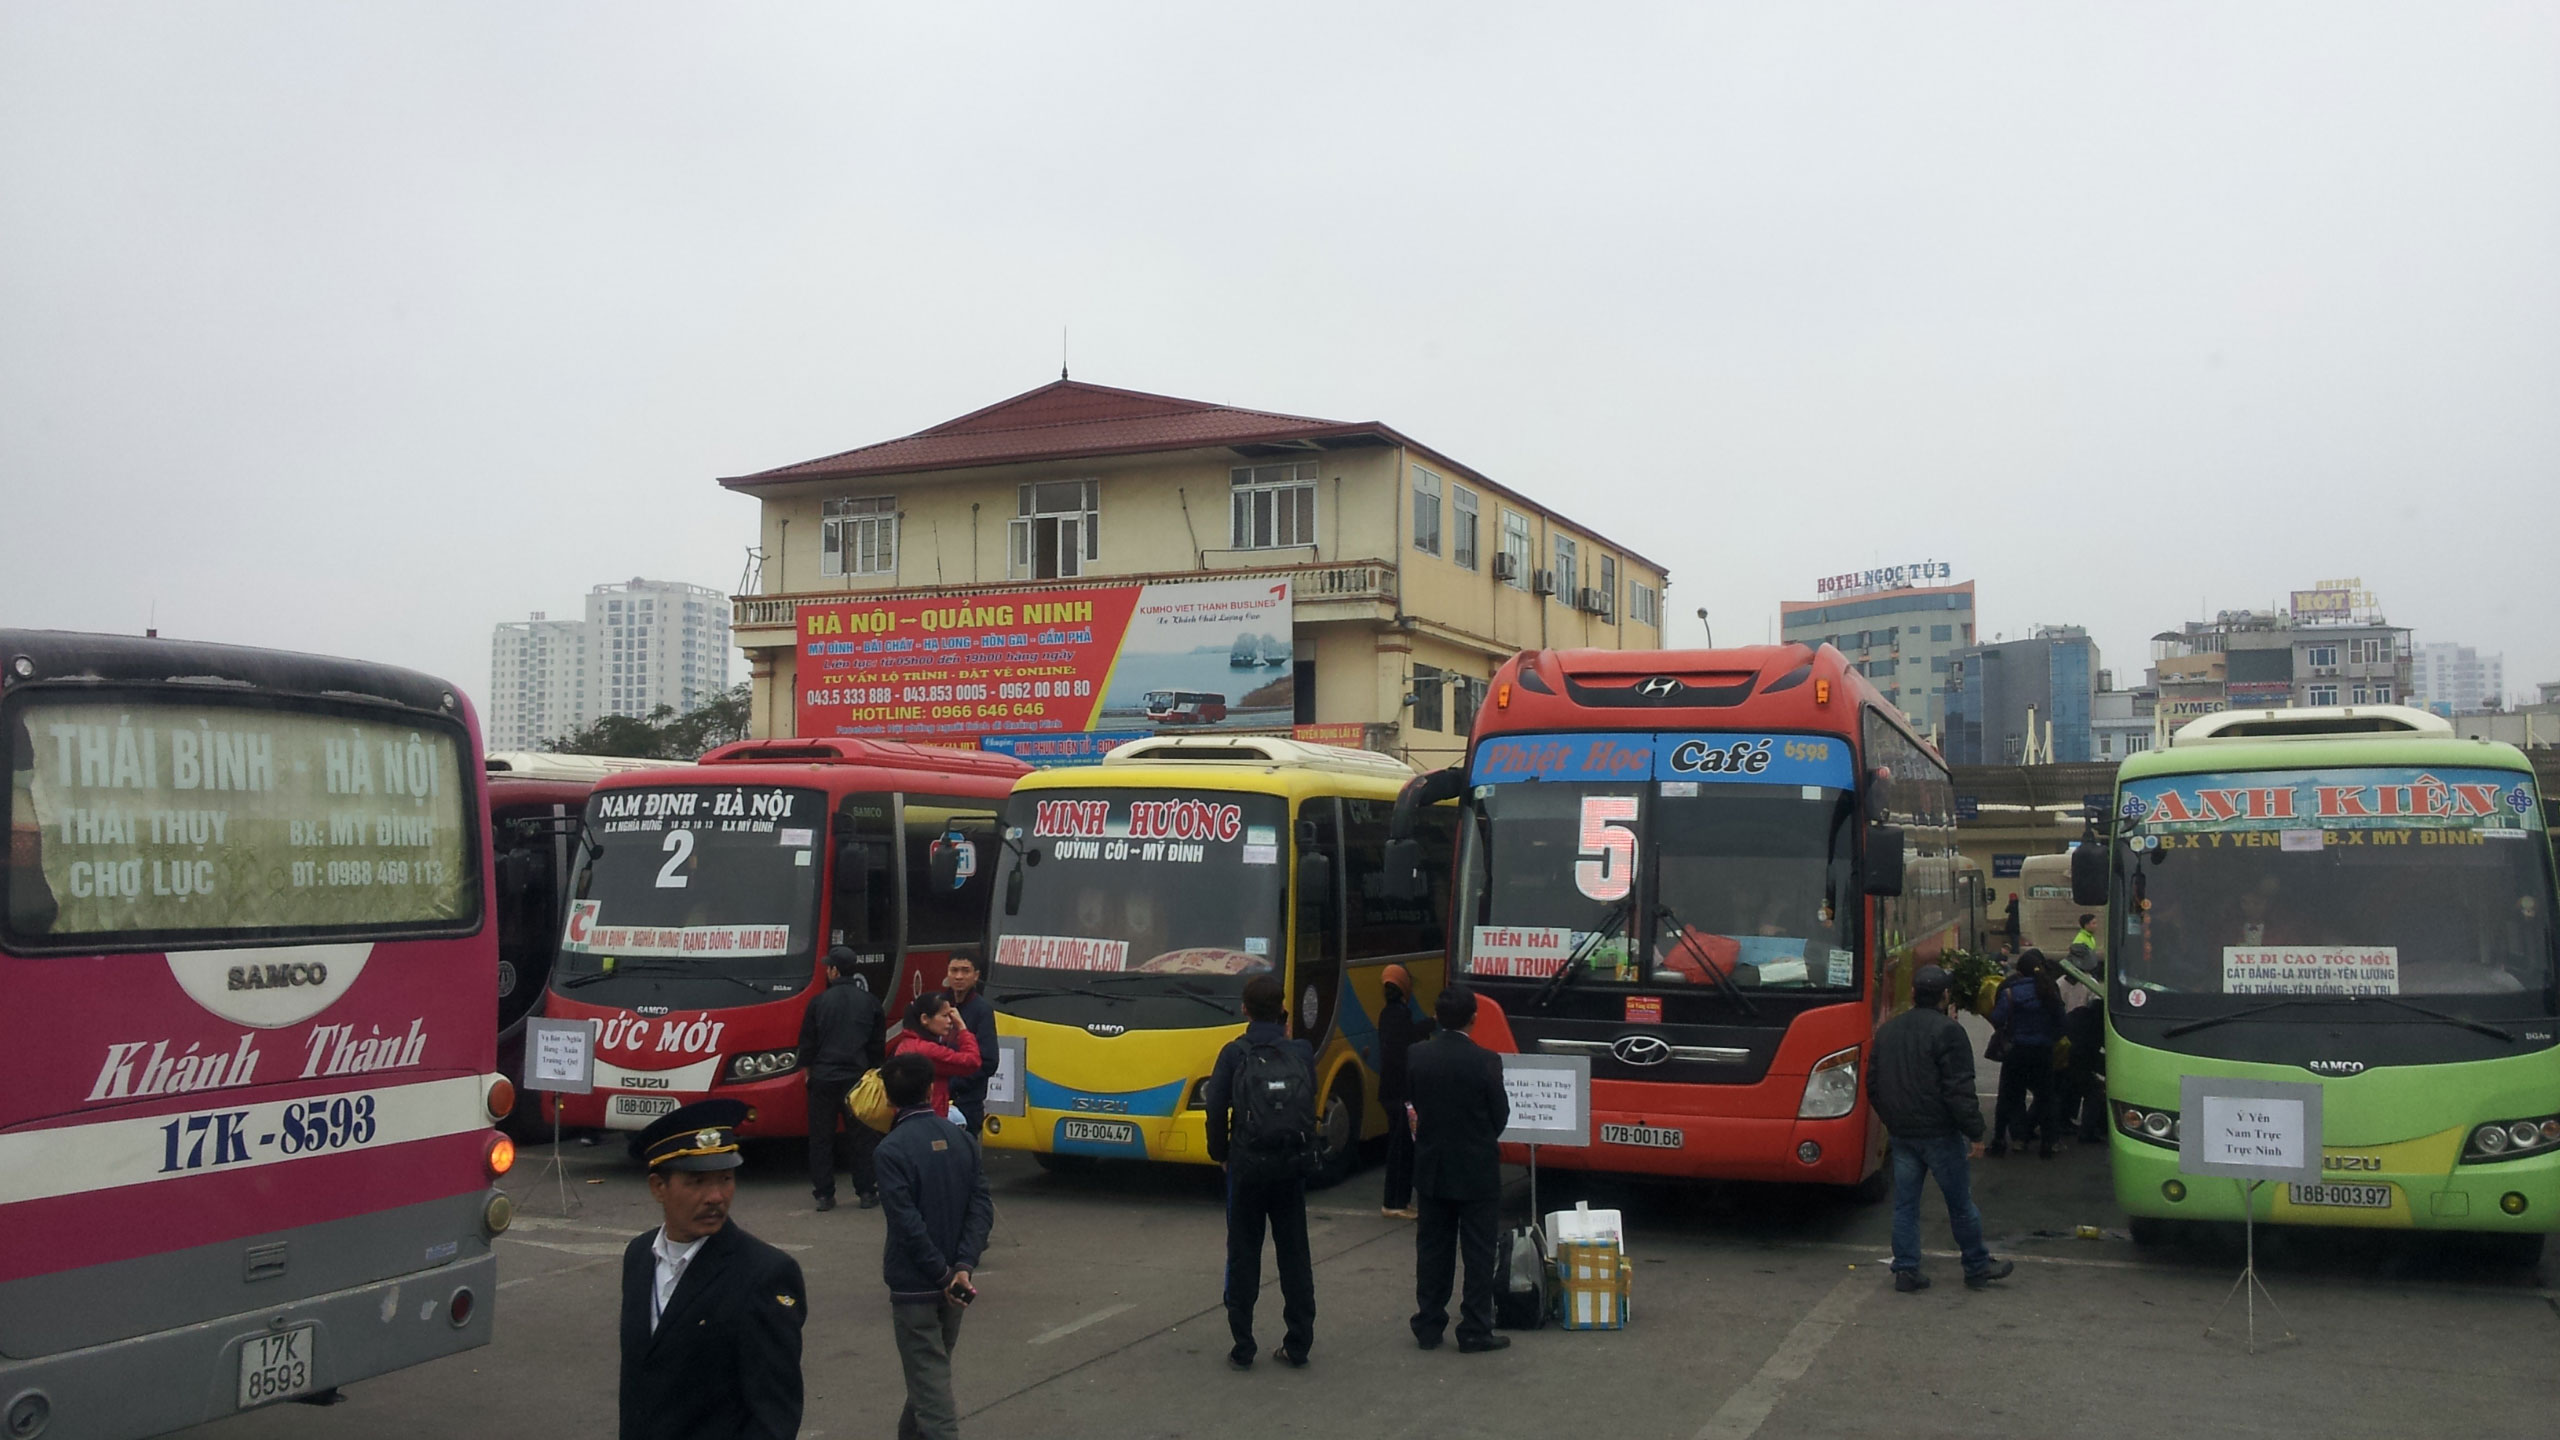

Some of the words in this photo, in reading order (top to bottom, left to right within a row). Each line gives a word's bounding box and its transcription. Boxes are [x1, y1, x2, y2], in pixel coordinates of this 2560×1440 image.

[1817, 573, 1861, 593] HOTEL
[1140, 604, 1173, 615] KUMHO
[1175, 603, 1194, 613] VIET
[1197, 601, 1228, 612] THANH
[1230, 599, 1276, 610] BUSLINES
[2296, 591, 2376, 611] HOTEL
[807, 611, 842, 635] HÀ
[850, 608, 896, 637] NỘI
[921, 599, 1014, 631] QUẢNG
[1023, 600, 1093, 625] NINH
[940, 636, 972, 650] LONG
[1008, 633, 1027, 646] GAI
[902, 668, 948, 681] TRÌNH
[1017, 665, 1076, 677] ONLINE:
[807, 688, 840, 706] 043.5
[843, 688, 866, 705] 333
[869, 686, 892, 703] 888
[903, 684, 952, 702] 043.853
[956, 682, 987, 700] 0005
[999, 682, 1031, 699] 0962
[1034, 681, 1050, 698] 00
[1054, 680, 1070, 697] 80
[1073, 680, 1091, 697] 80
[852, 706, 926, 721] HOTLINE:
[931, 705, 972, 719] 0966
[976, 703, 1009, 717] 646
[1013, 702, 1045, 716] 646
[1014, 741, 1031, 755] KIM
[1483, 742, 1573, 776] Phiệt
[1582, 741, 1650, 776] Học
[1670, 738, 1773, 773] Café
[1784, 741, 1828, 762] 6598
[50, 714, 157, 788] THÁI
[171, 718, 273, 790] BÌNH
[326, 728, 374, 794] HÀ
[383, 732, 439, 807] NỘI
[599, 795, 642, 818] NAM
[644, 793, 698, 819] ĐỊNH
[713, 788, 745, 816] HÀ
[751, 789, 794, 821] NỘI
[2145, 786, 2298, 823] ANH
[2314, 773, 2500, 818] KIÊN
[853, 807, 882, 817] SAMCO
[1033, 800, 1110, 837] MINH
[1128, 798, 1242, 842] HƯƠNG
[151, 810, 228, 851] THỤY
[290, 819, 324, 845] BX:
[376, 808, 433, 846] ĐÌNH
[752, 819, 774, 833] ĐÌNH
[1574, 796, 1639, 902] 5
[2160, 835, 2200, 850] B.X
[2231, 831, 2279, 847] YÊN
[2322, 830, 2364, 845] B.X
[2420, 828, 2485, 845] ĐÌNH
[655, 829, 694, 888] 2
[1054, 838, 1099, 860] QUỲNH
[1104, 838, 1129, 861] CÔI
[1142, 840, 1166, 861] MỸ
[1167, 841, 1203, 863] ĐÌNH
[69, 858, 143, 903] CHỢ
[153, 859, 215, 903] LỤC
[292, 861, 324, 887] ĐT:
[327, 861, 372, 886] 0988
[378, 861, 409, 884] 469
[414, 860, 442, 885] 113
[739, 931, 760, 949] NAM
[1473, 957, 1509, 976] NAM
[1514, 958, 1569, 977] TRUNG
[2234, 954, 2256, 965] XE
[2260, 954, 2277, 964] ĐI
[2284, 954, 2317, 965] CAO
[2322, 950, 2355, 965] TỐC
[2360, 951, 2390, 966] MỚI
[227, 961, 327, 991] SAMCO
[2232, 982, 2252, 994] YÊN
[637, 1005, 668, 1015] SAMCO
[655, 1011, 725, 1053] MỚI
[1088, 1023, 1125, 1034] SAMCO
[85, 1032, 260, 1101] Khánh
[299, 1017, 428, 1079] Thành
[2309, 1060, 2364, 1072] SAMCO
[621, 1077, 669, 1088] ISUZU
[1072, 1097, 1128, 1112] ISUZU
[2237, 1109, 2245, 1121] Ý
[2249, 1111, 2270, 1123] Yên
[1069, 1123, 1130, 1141] 17B-004.47
[1604, 1125, 1681, 1146] 17B-001.68
[2226, 1128, 2251, 1138] Nam
[2255, 1129, 2282, 1142] Trực
[2225, 1144, 2252, 1157] Trực
[2256, 1144, 2282, 1156] Ninh
[2322, 1156, 2381, 1170] UZU
[2295, 1186, 2386, 1205] 18B-003.97
[260, 1333, 298, 1366] 17K
[249, 1363, 305, 1399] 8593
